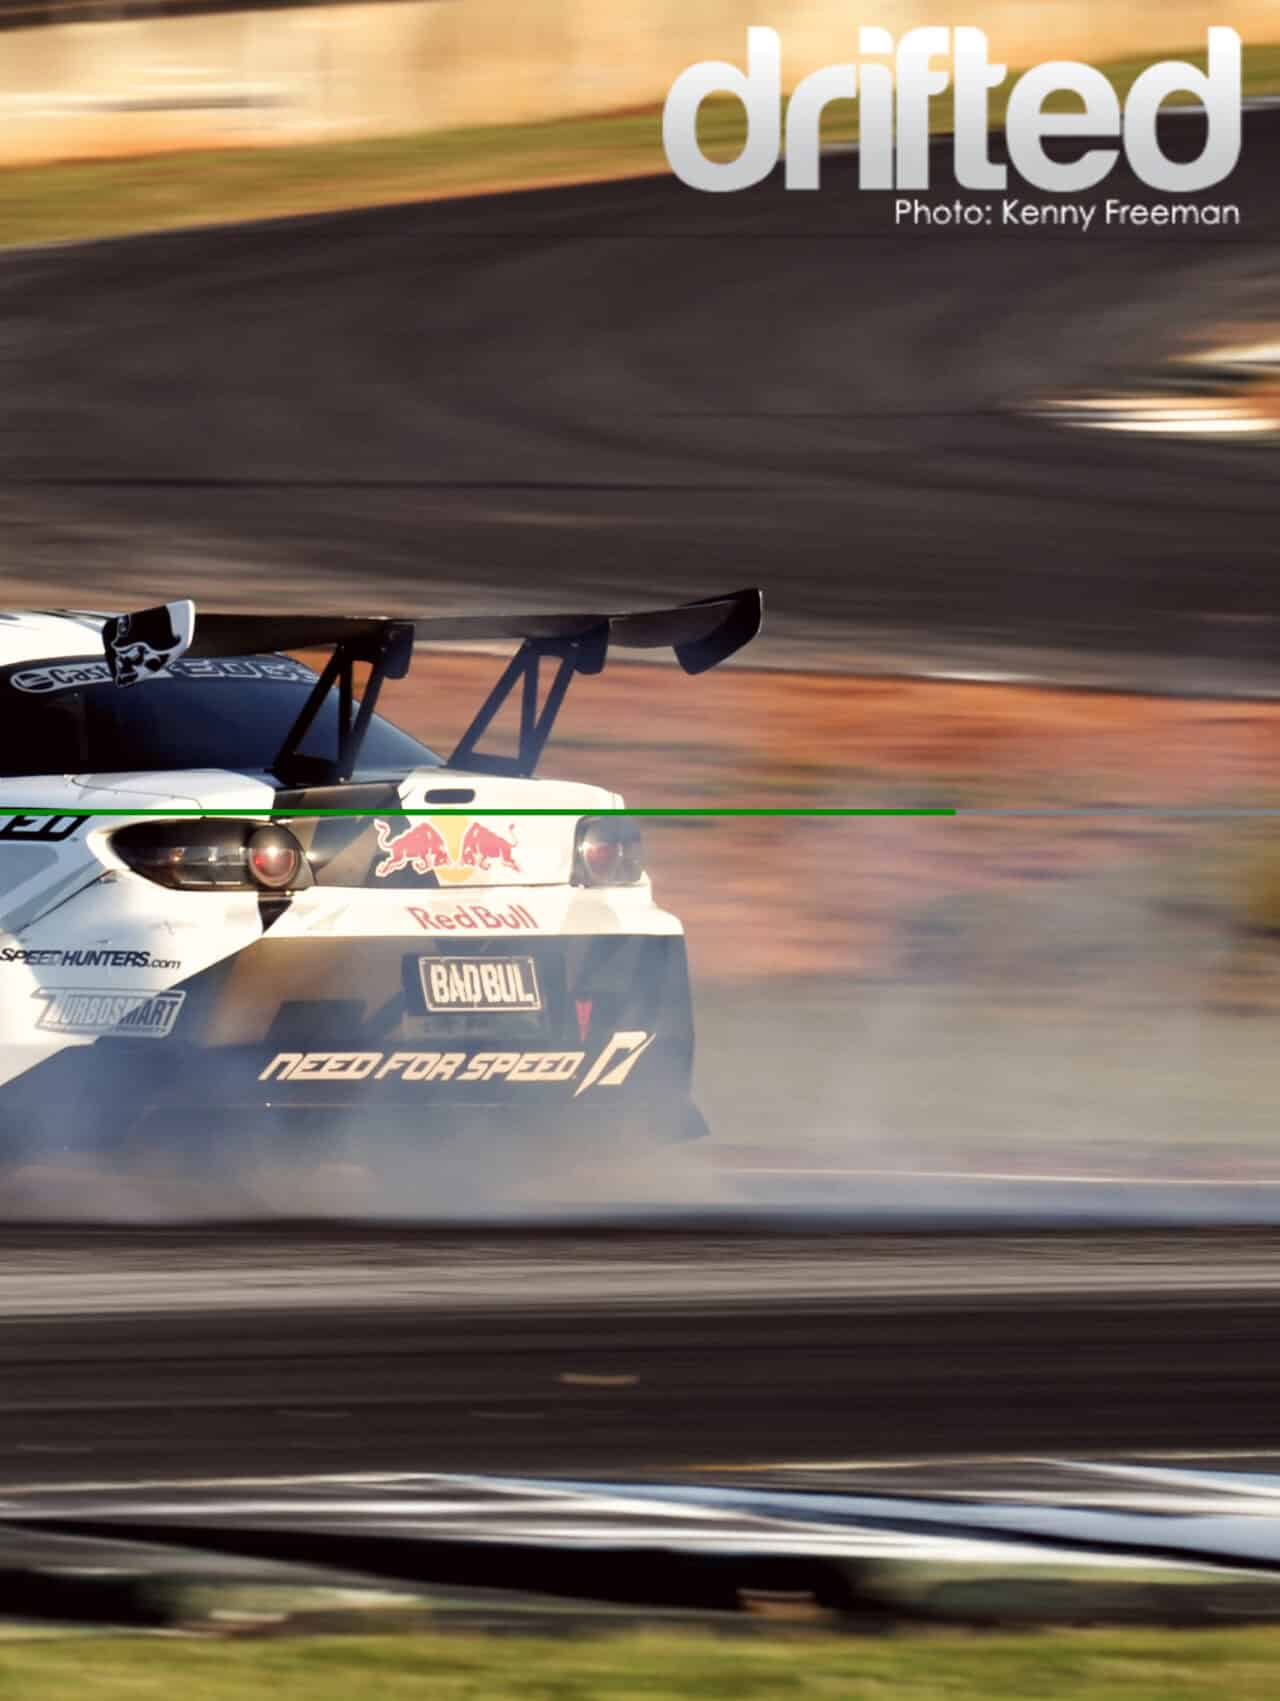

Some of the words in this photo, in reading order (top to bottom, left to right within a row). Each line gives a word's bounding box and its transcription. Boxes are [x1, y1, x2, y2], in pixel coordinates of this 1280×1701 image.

[50, 662, 113, 685] Cast
[258, 1051, 384, 1081] NEED
[374, 1051, 468, 1081] FOR
[456, 1051, 586, 1081] SPEED
